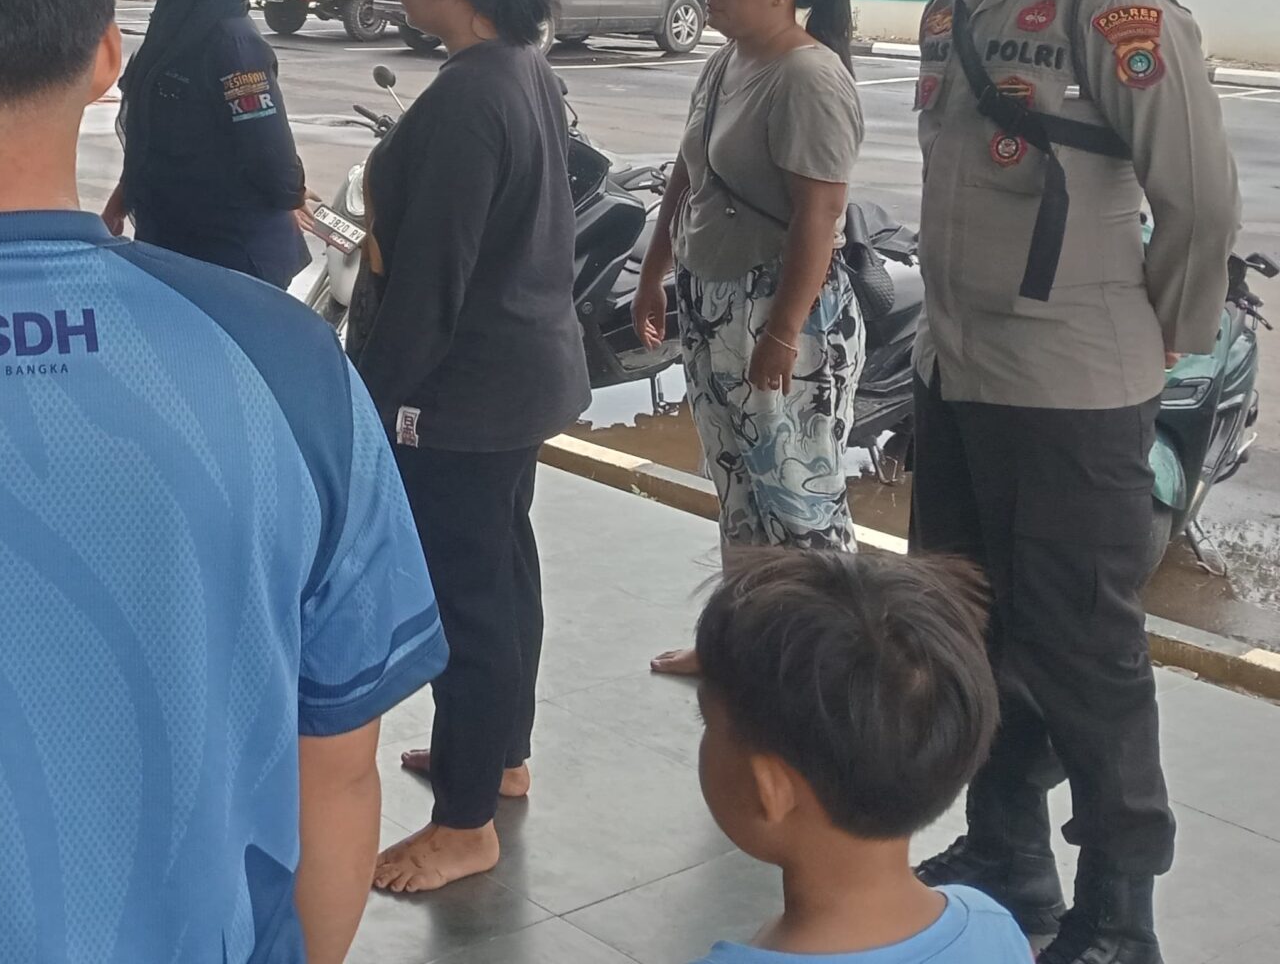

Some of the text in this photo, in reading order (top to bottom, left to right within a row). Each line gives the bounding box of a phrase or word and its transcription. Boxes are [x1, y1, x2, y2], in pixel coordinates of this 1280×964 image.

[985, 39, 1066, 70] POLRI
[315, 208, 329, 221] BN
[5, 363, 69, 376] BANGKA
